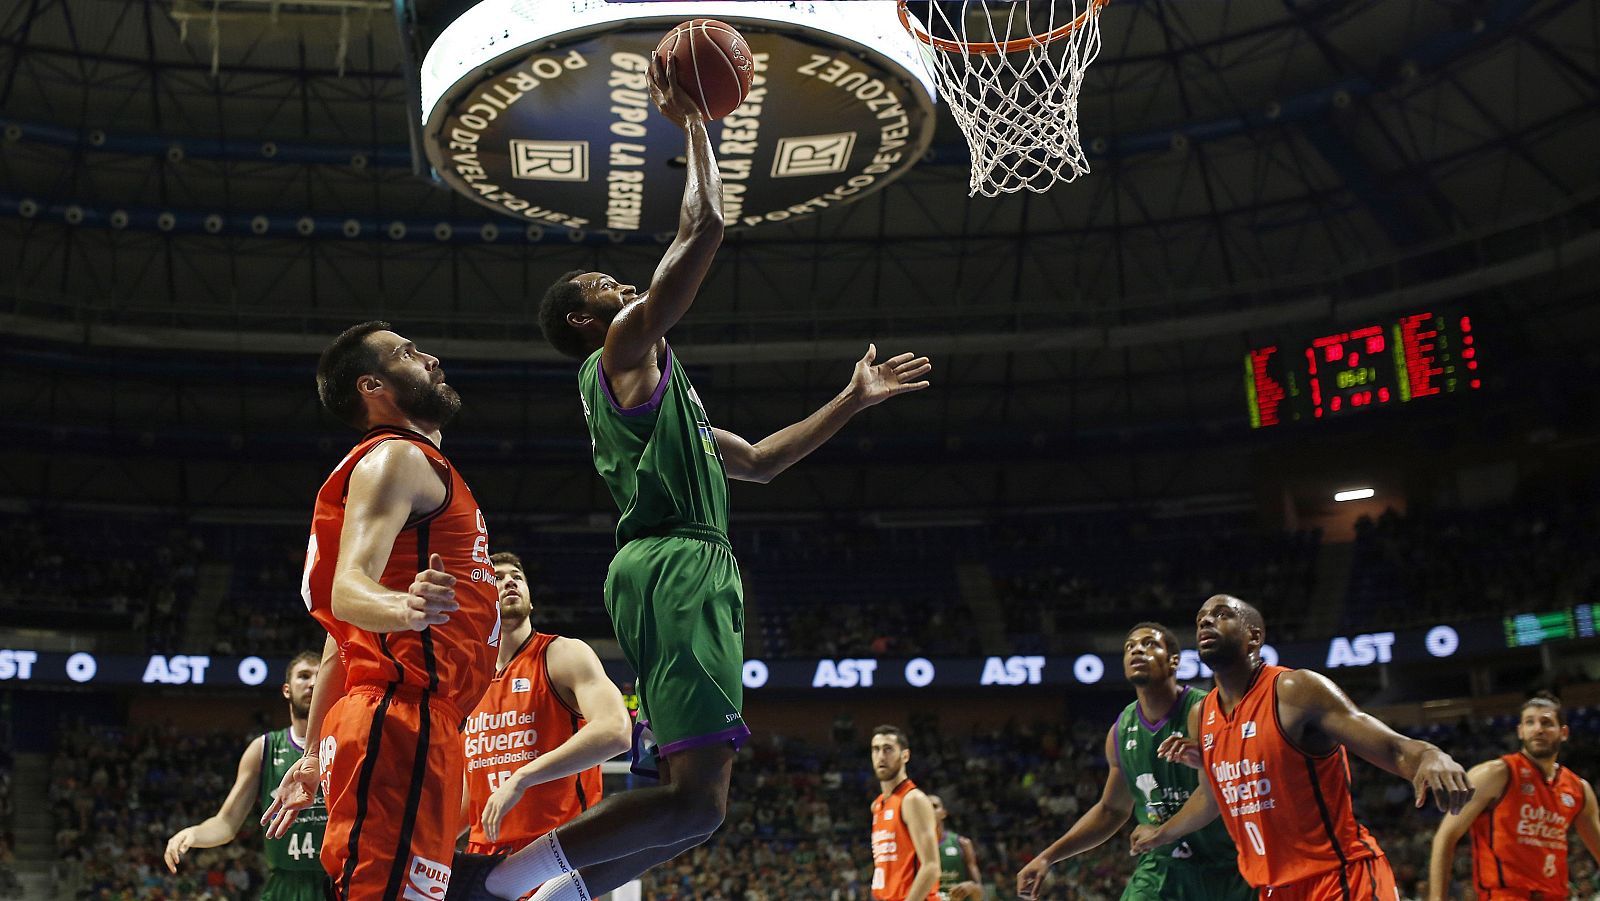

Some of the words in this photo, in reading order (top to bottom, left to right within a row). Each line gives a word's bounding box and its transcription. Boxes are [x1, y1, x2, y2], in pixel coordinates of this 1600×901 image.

[459, 50, 588, 130] PORTICO
[609, 51, 650, 137] GRUPO
[797, 54, 909, 153] VELAZQUEZ
[449, 128, 480, 153] DE
[608, 142, 646, 166] LA
[718, 159, 752, 180] LA
[452, 153, 590, 229] VELAZQUEZ
[744, 175, 875, 227] PORTICO
[143, 655, 209, 684] AST
[812, 658, 877, 688] AST
[980, 655, 1045, 685] AST
[1326, 631, 1395, 669] AST
[518, 712, 535, 725] del
[288, 832, 315, 860] 44
[414, 862, 450, 884] PULE
[1543, 853, 1557, 877] 8
